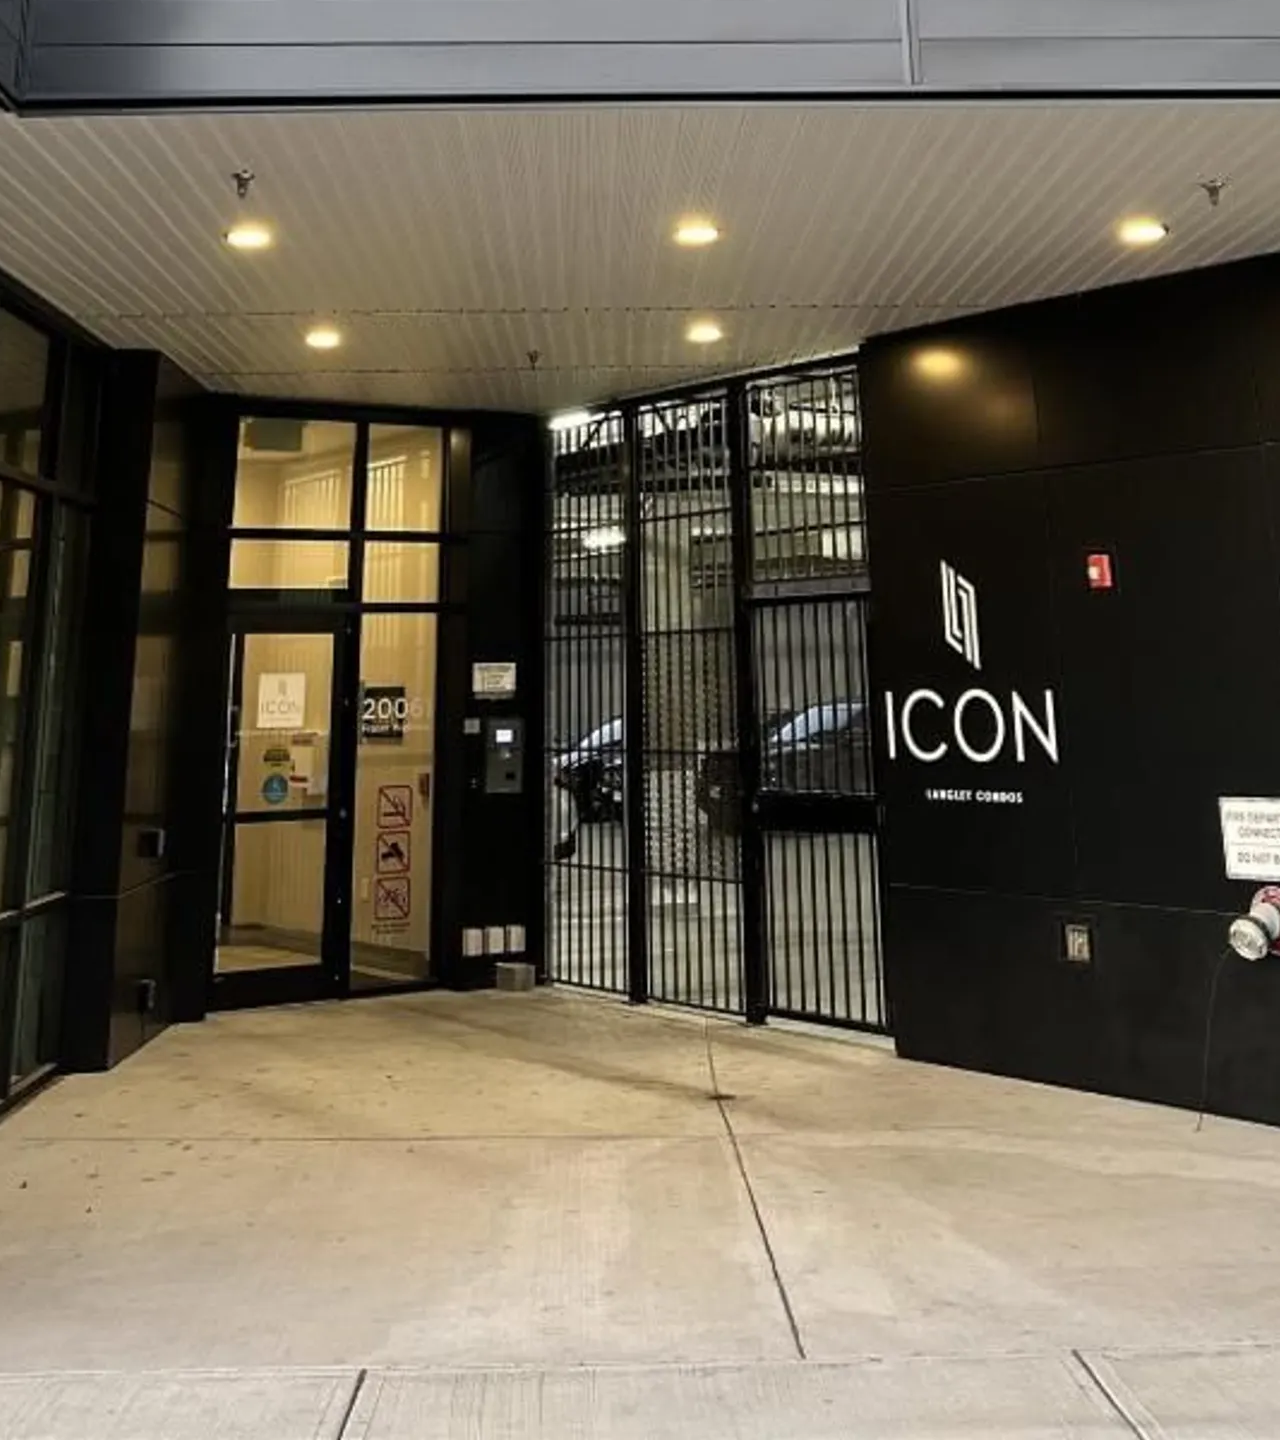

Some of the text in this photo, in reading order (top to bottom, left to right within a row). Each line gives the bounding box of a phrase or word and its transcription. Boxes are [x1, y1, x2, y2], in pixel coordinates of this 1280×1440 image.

[885, 688, 1058, 762] ICON
[925, 788, 1023, 803] LANGLEY CONDOS
